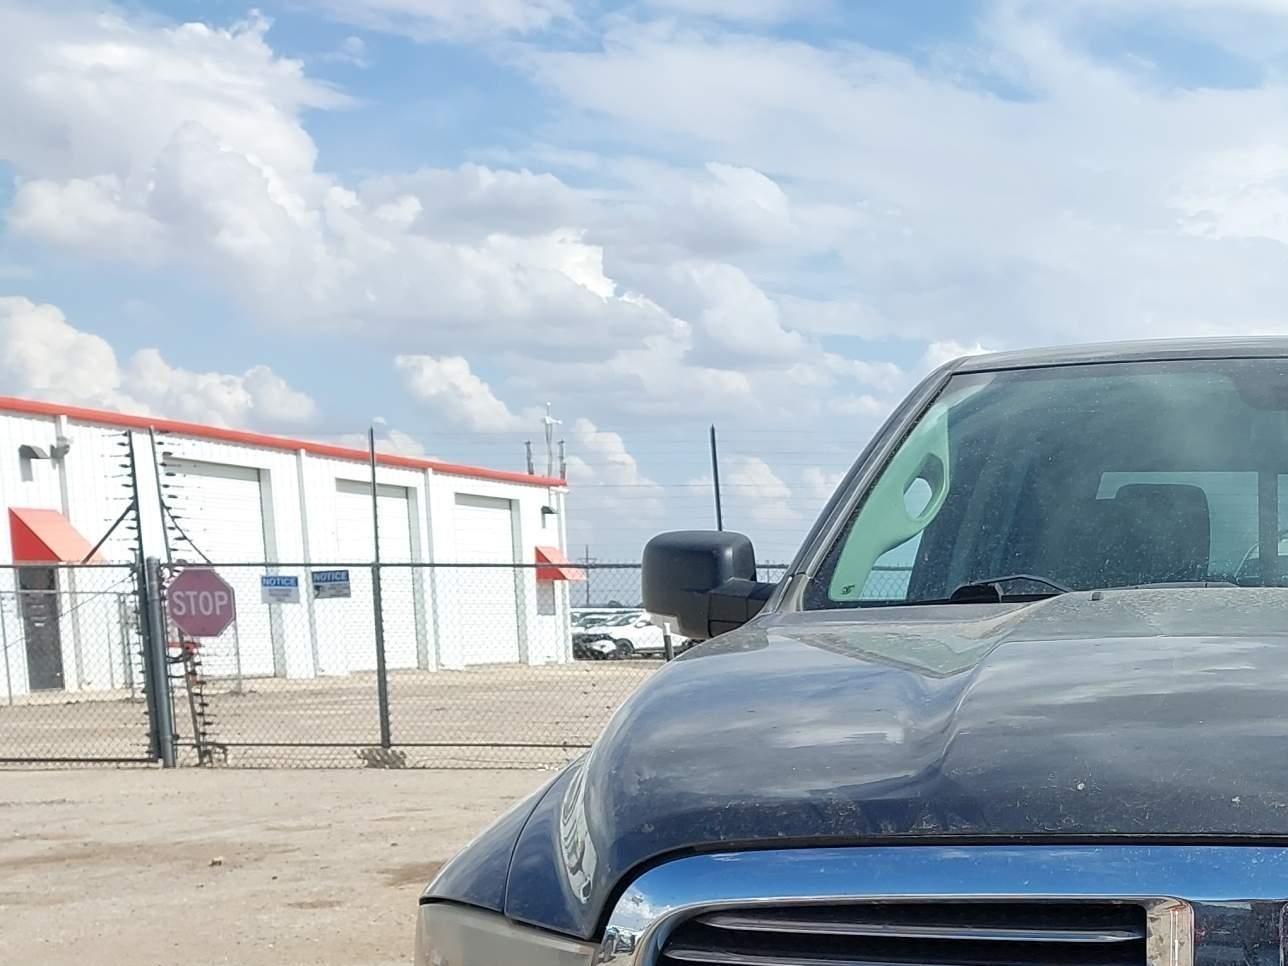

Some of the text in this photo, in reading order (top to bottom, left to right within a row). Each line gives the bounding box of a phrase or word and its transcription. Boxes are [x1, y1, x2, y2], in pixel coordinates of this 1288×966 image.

[262, 577, 297, 587] NOTICE
[312, 571, 348, 583] NOTICE
[172, 590, 228, 616] STOP
